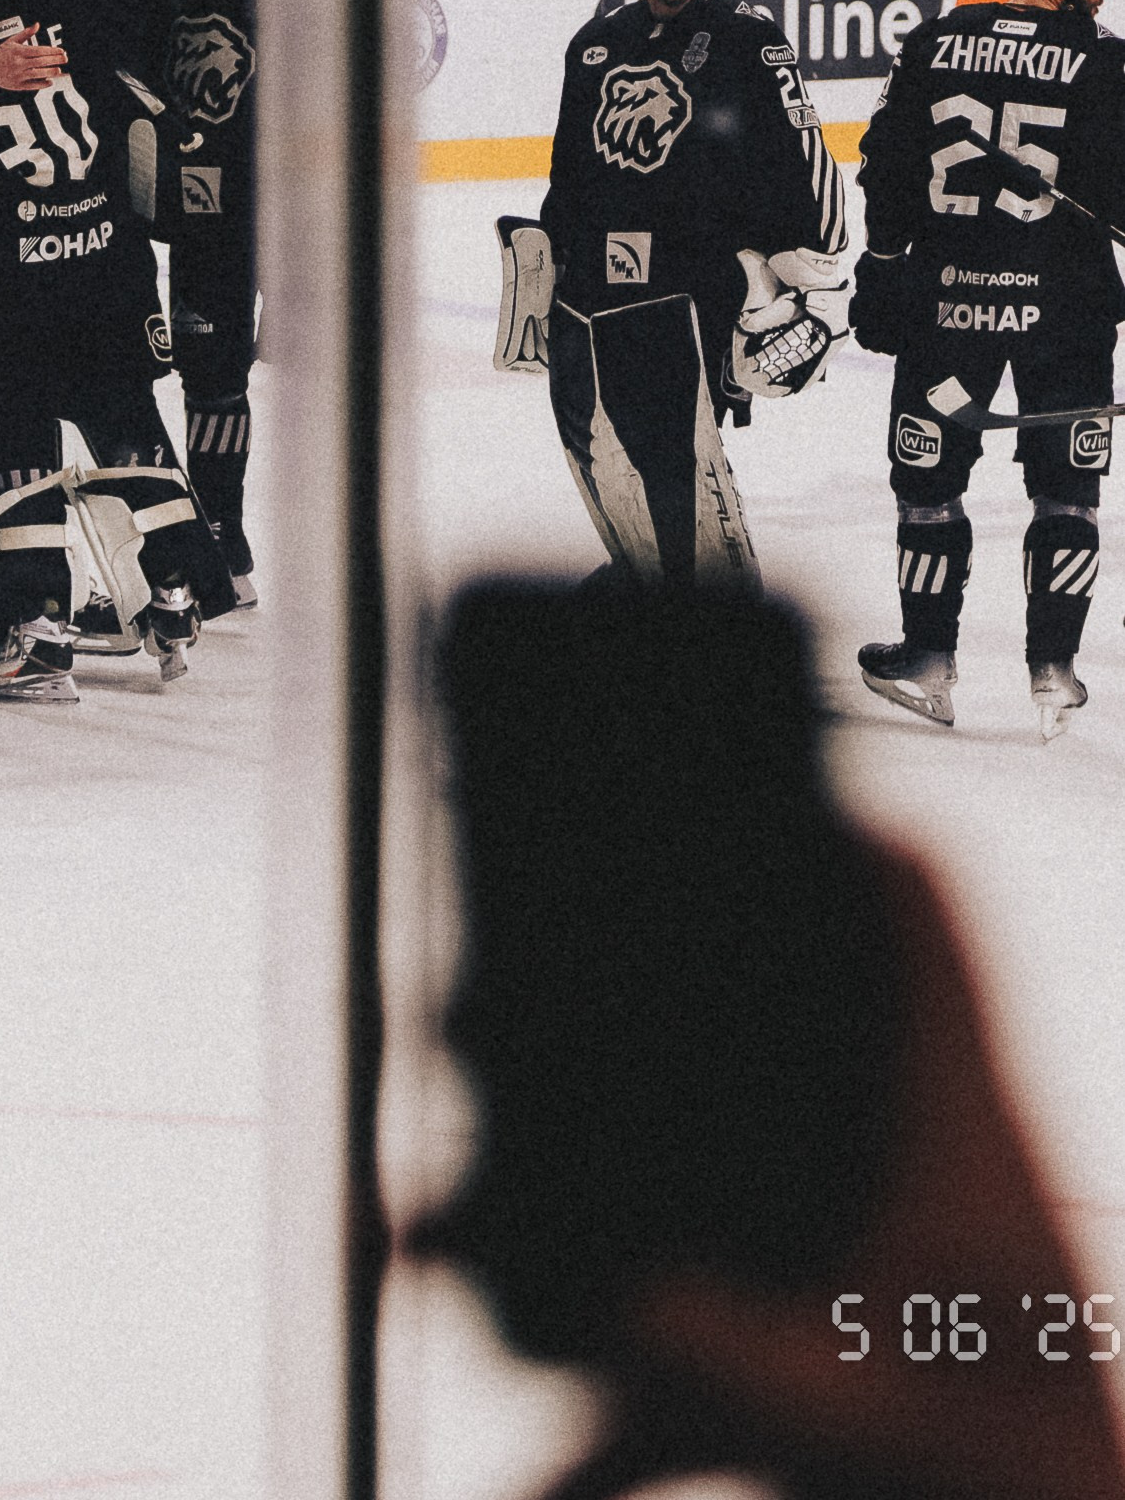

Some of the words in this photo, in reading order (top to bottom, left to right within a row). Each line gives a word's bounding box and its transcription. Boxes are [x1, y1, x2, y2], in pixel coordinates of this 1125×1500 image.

[931, 35, 1086, 83] ZHARKOV
[928, 93, 1066, 222] 25
[40, 191, 108, 218] МЕГАФОН
[20, 221, 114, 262] КОНАР
[958, 269, 1039, 286] МЕГАФОН
[938, 302, 1041, 332] КОНАР
[904, 432, 937, 453] Win
[1082, 433, 1109, 451] Win
